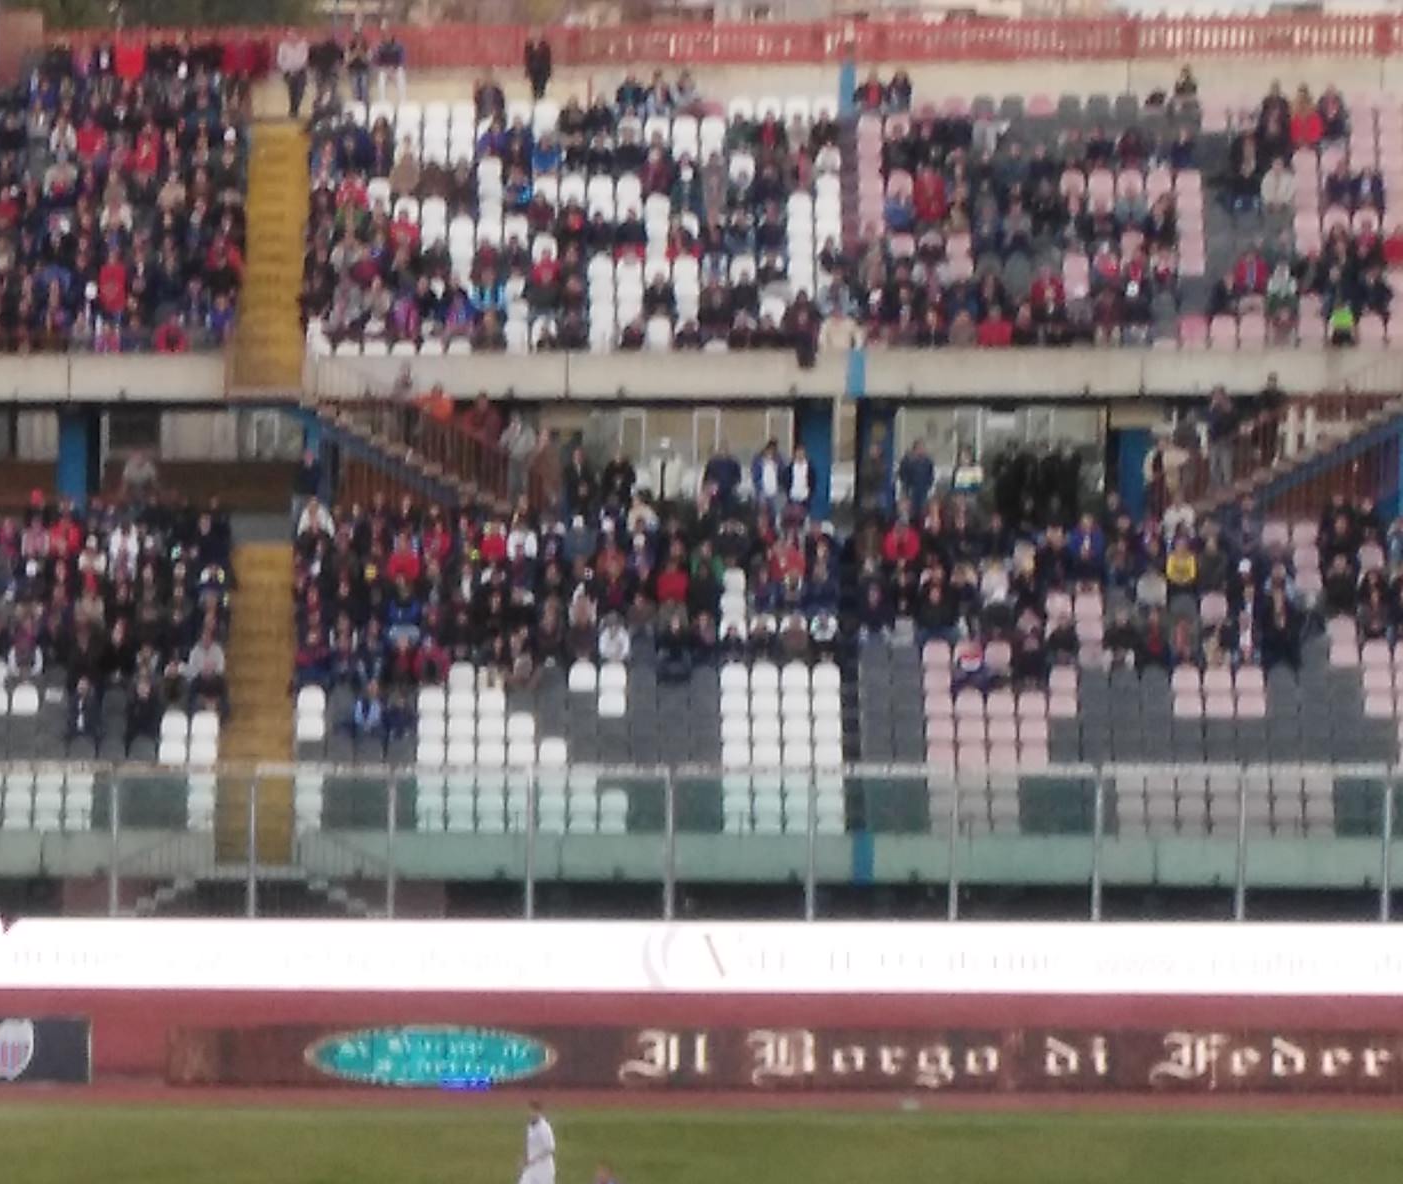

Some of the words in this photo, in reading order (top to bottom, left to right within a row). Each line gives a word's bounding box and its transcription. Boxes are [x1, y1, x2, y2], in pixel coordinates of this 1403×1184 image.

[617, 1028, 709, 1084] Il
[746, 1027, 999, 1089] Borgo
[1045, 1035, 1108, 1077] di
[1148, 1030, 1394, 1091] Feder
